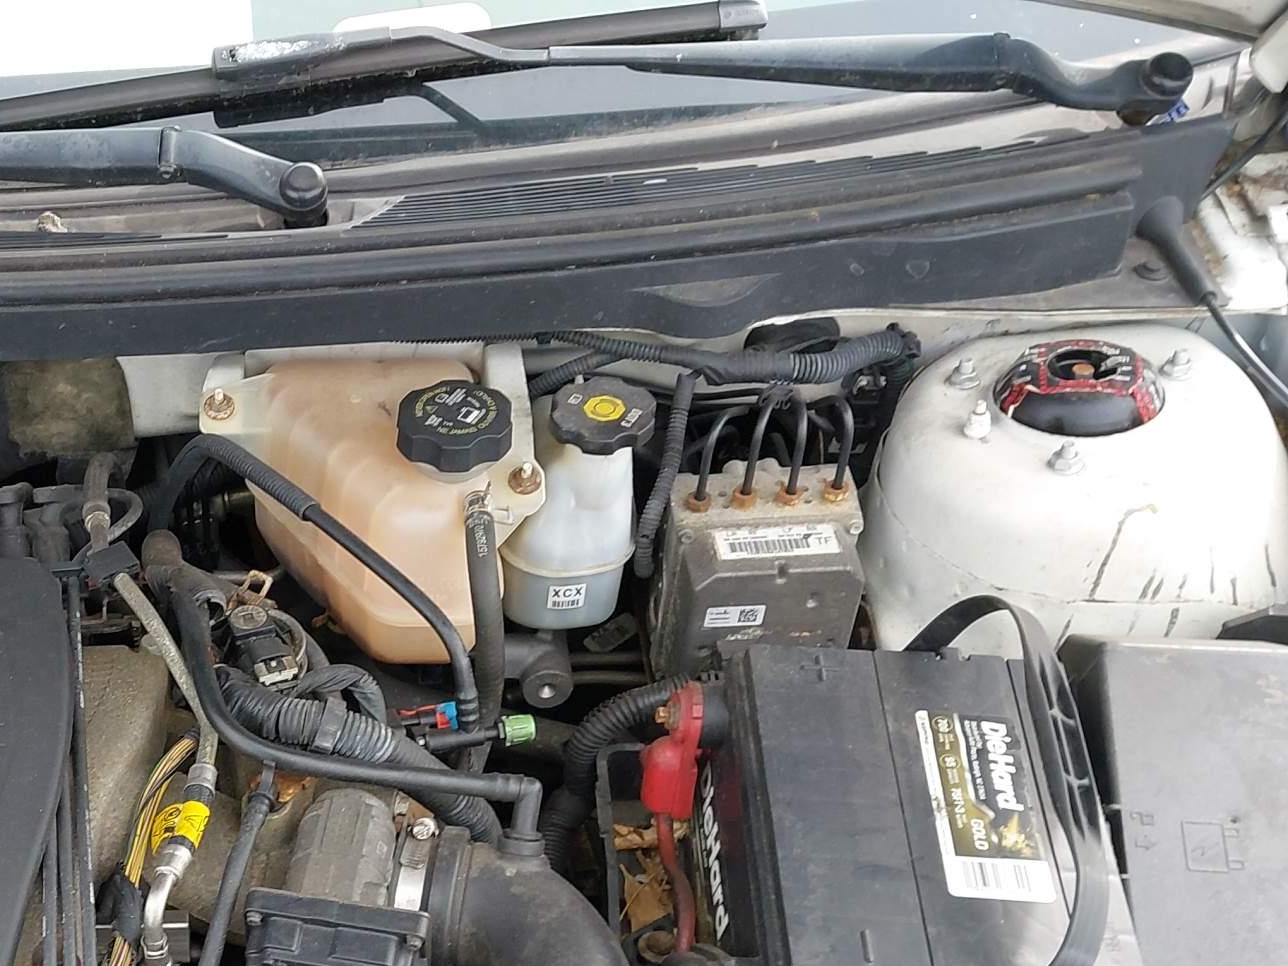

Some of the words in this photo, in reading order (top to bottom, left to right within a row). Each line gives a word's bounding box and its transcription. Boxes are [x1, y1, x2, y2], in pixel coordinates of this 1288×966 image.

[552, 586, 584, 598] XCX
[980, 721, 1024, 811] DieHard
[700, 760, 730, 941] DieHard
[971, 818, 989, 850] GOLD
